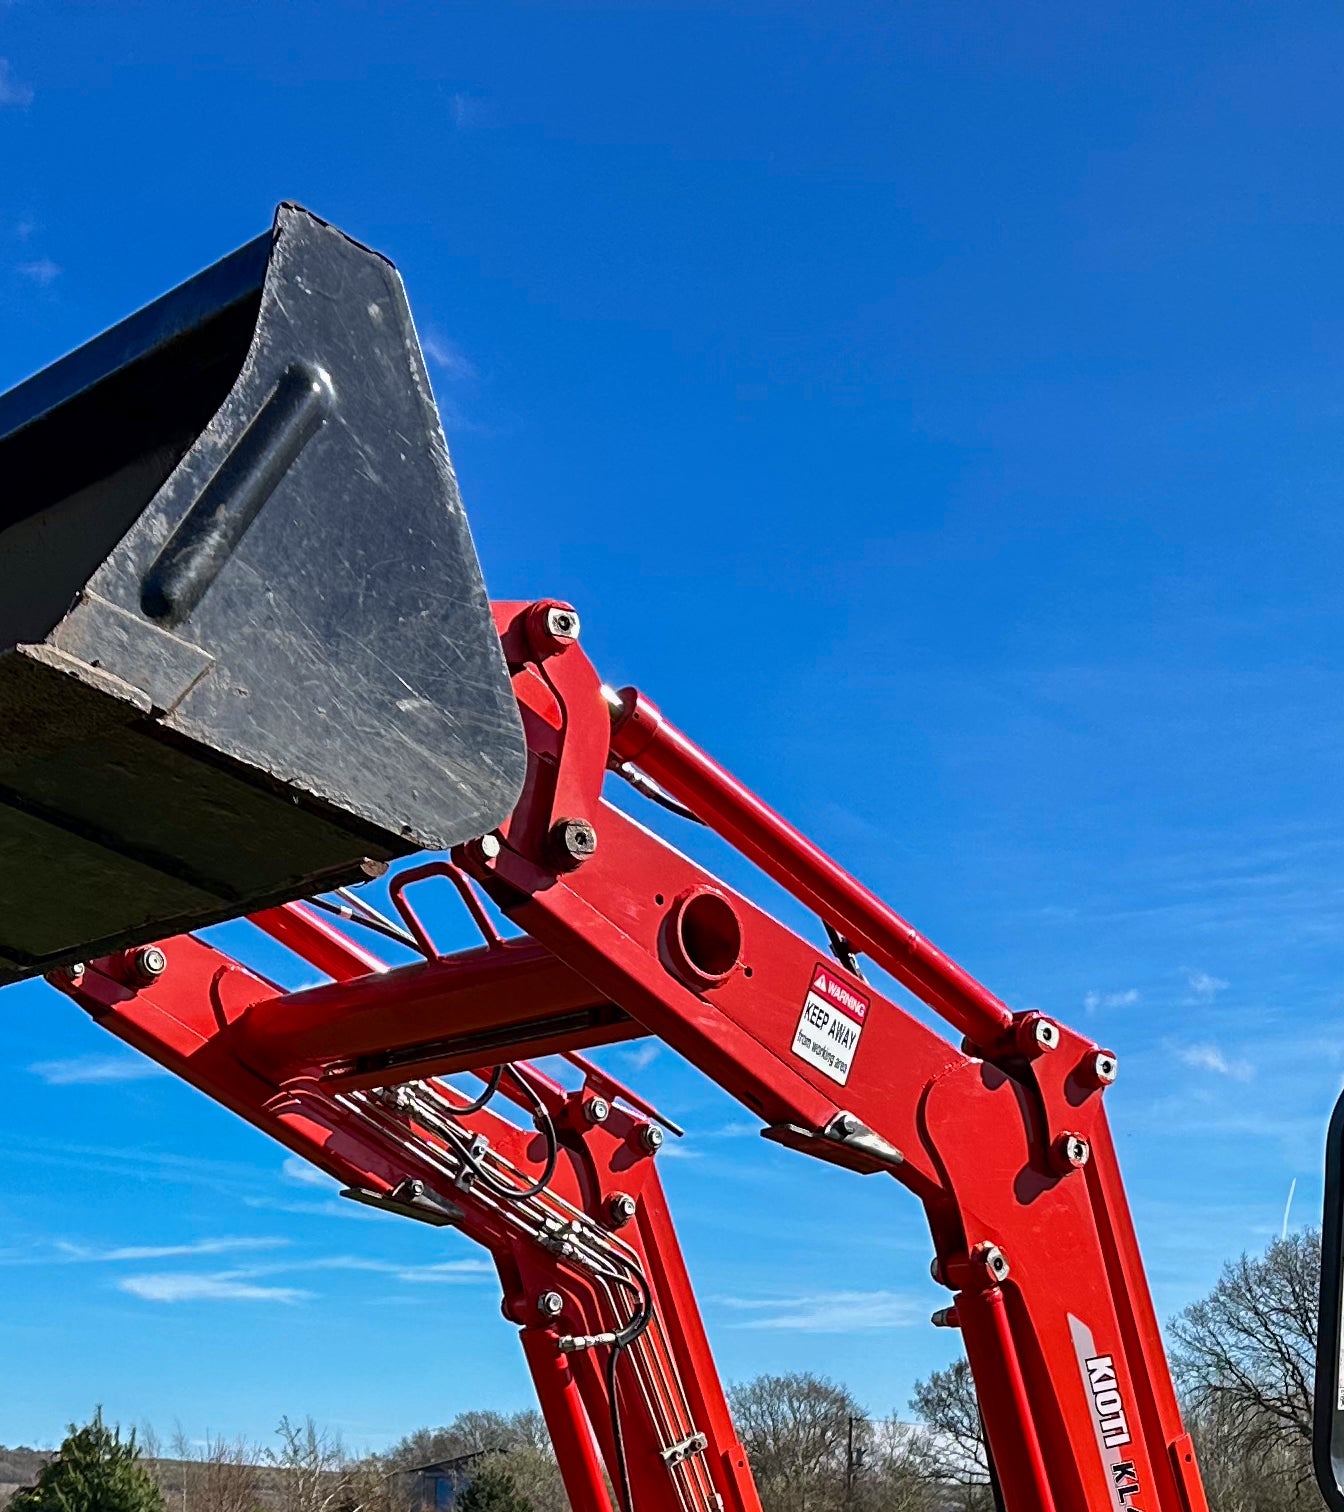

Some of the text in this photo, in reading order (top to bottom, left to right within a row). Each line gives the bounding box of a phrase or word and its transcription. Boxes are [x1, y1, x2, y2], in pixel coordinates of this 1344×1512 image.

[827, 980, 866, 1018] WARNING
[804, 1000, 856, 1050] KEEP AWAY
[797, 1028, 848, 1074] from working area
[1085, 1354, 1132, 1449] KIOTI
